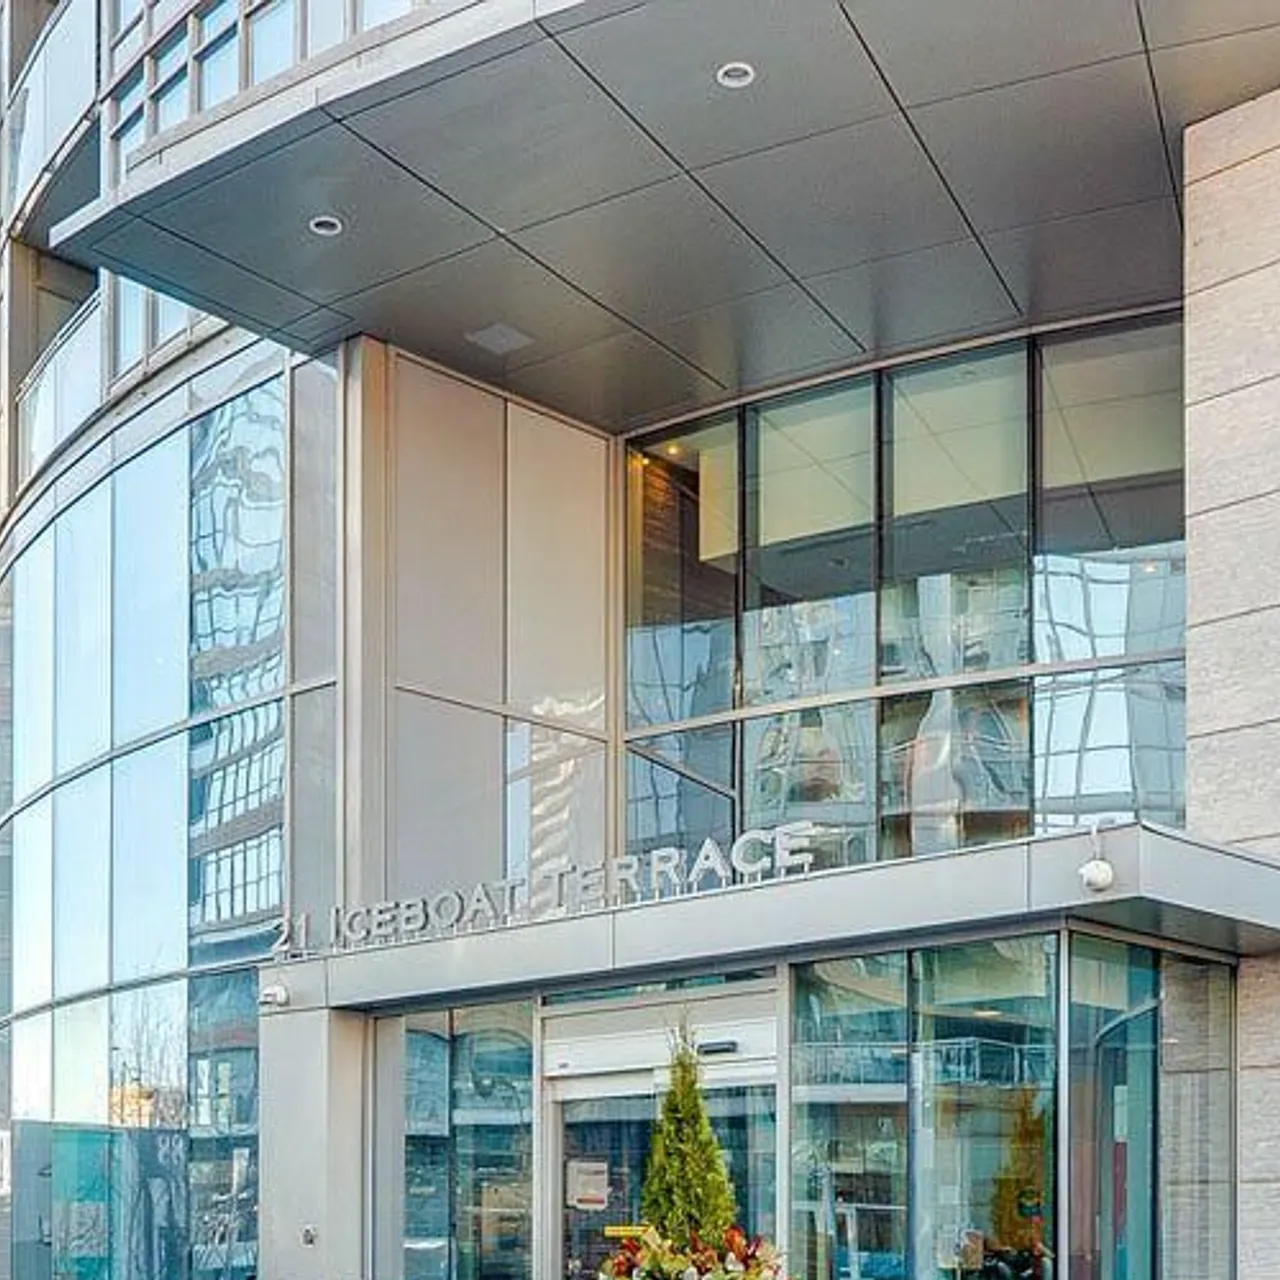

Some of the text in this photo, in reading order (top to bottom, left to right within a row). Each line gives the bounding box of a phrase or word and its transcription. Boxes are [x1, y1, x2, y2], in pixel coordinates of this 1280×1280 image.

[272, 820, 815, 950] 21 ICEBOAT TERRACE
